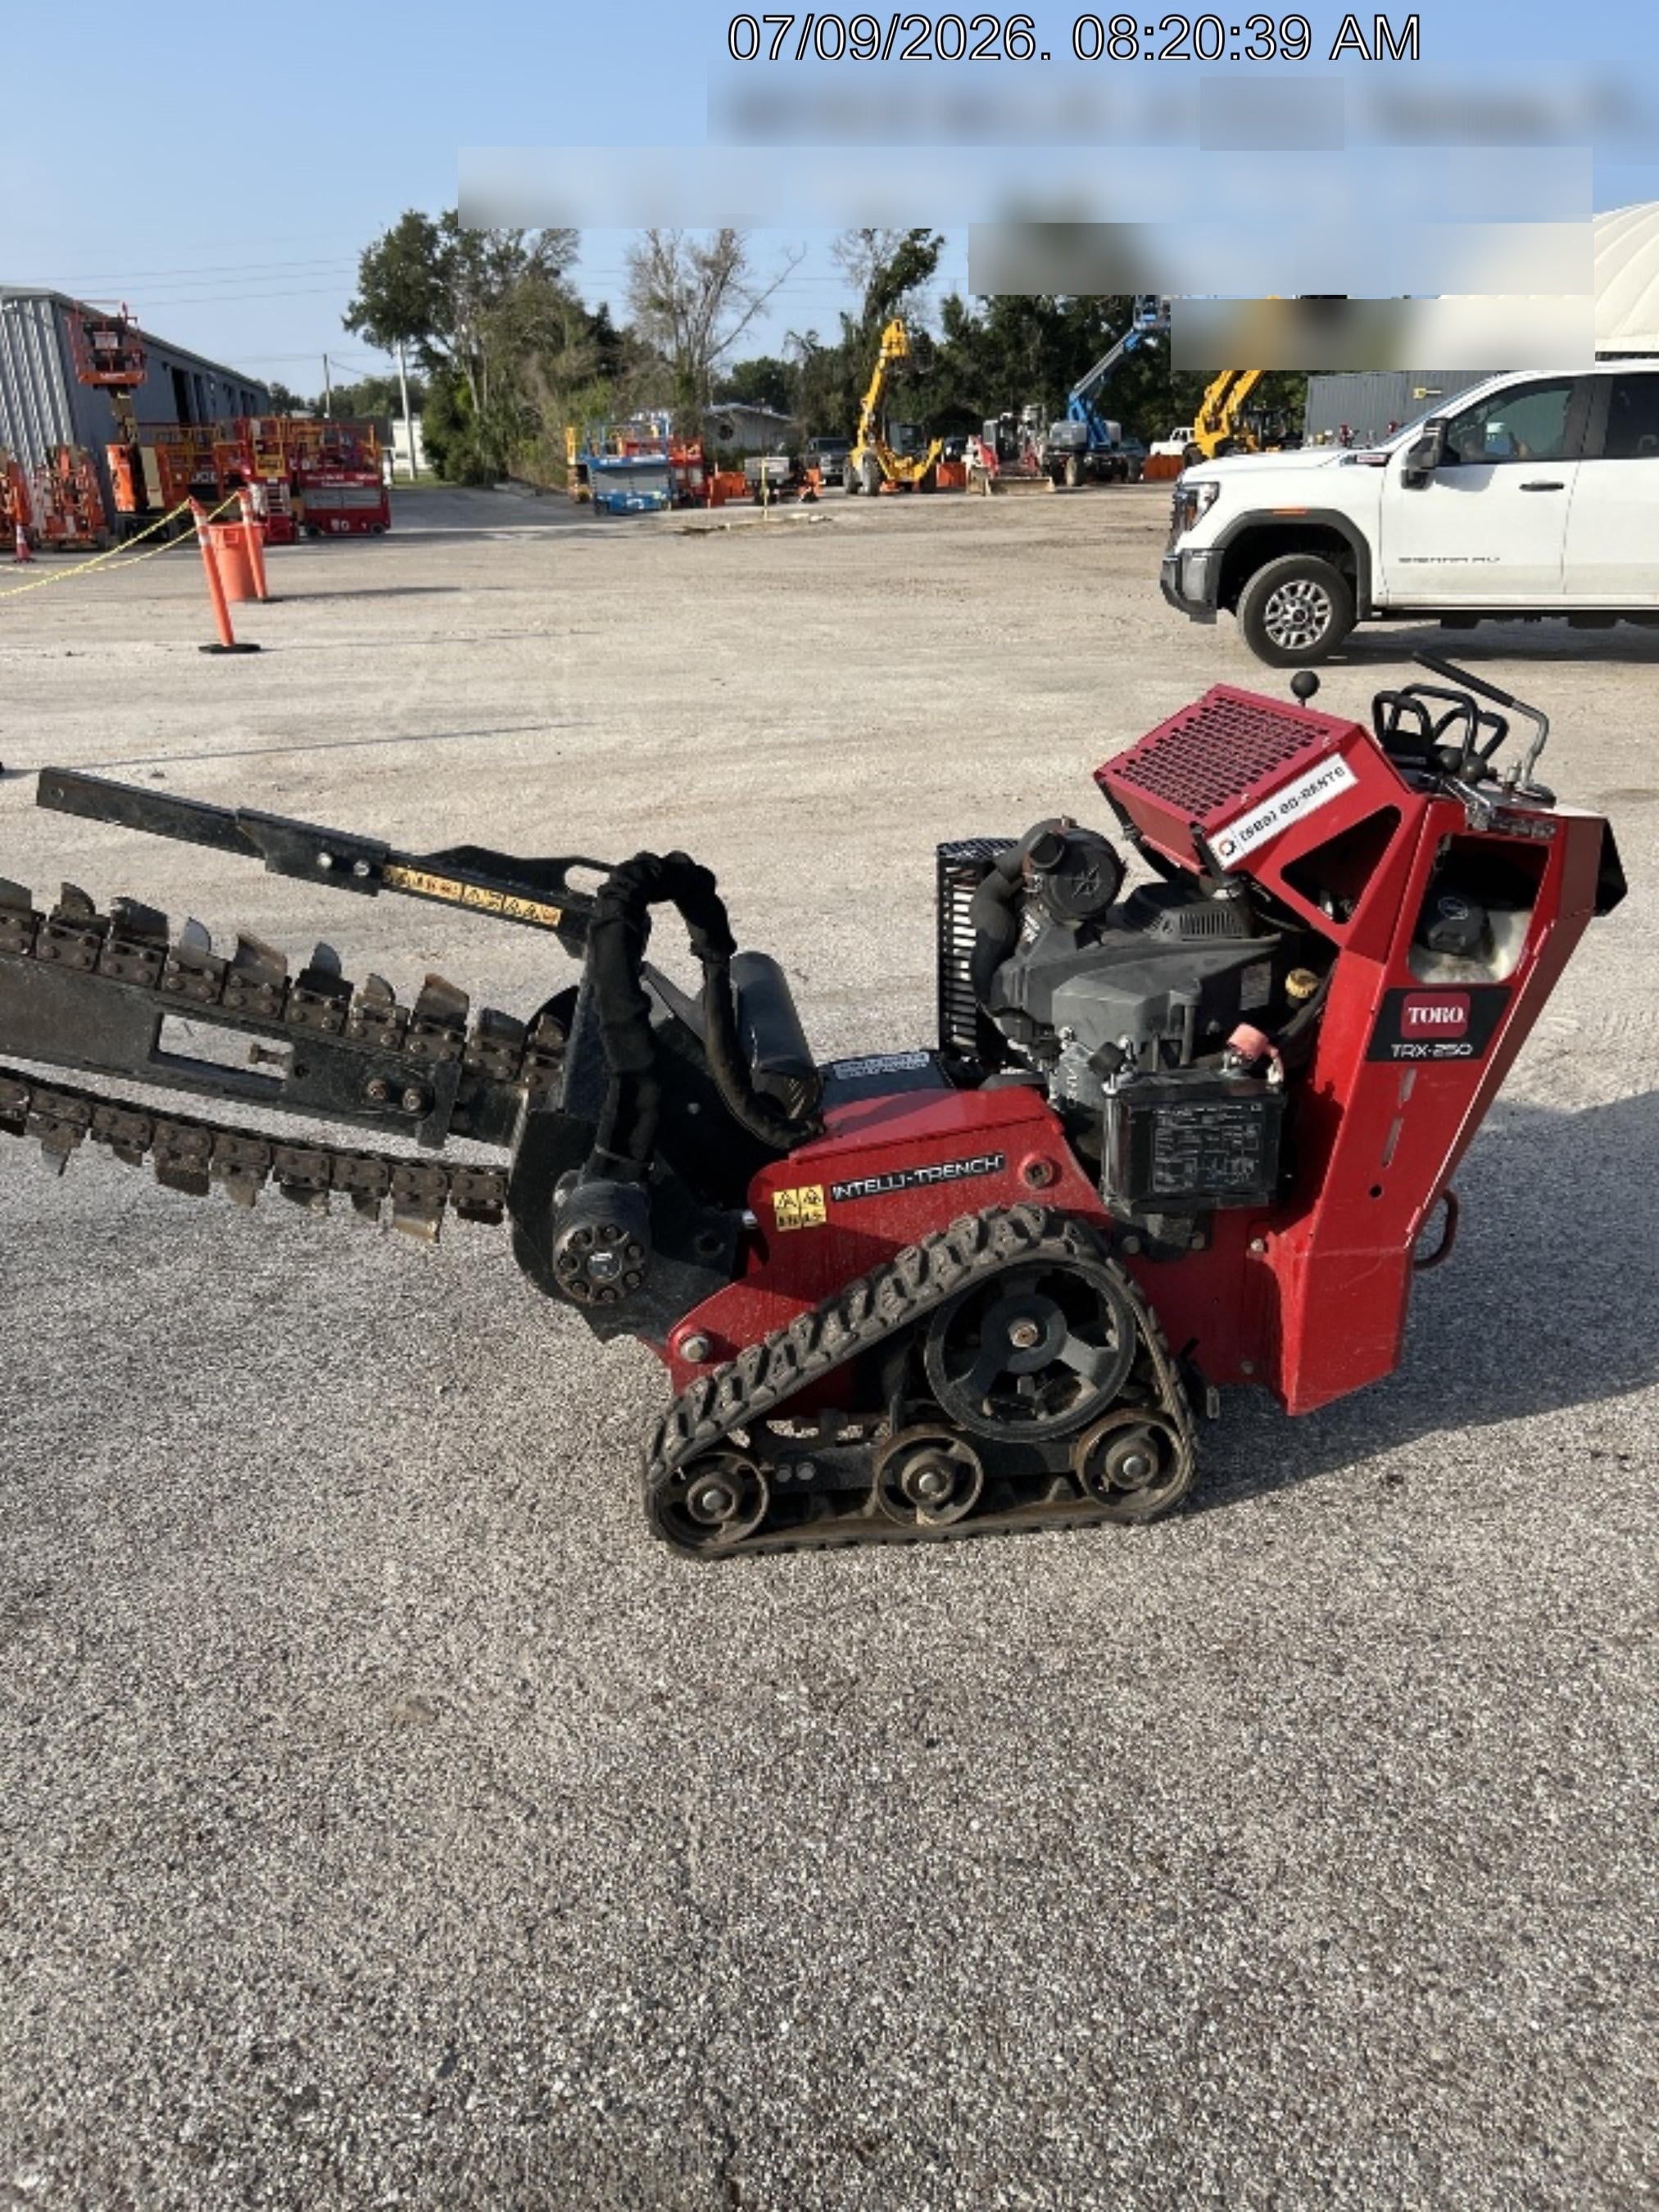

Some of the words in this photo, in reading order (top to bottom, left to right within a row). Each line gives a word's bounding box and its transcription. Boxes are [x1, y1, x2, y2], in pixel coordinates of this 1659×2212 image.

[1407, 1006, 1465, 1024] TORO
[1391, 1043, 1474, 1058] TRX-250
[832, 1154, 1004, 1200] INTELLI-TRENCH
